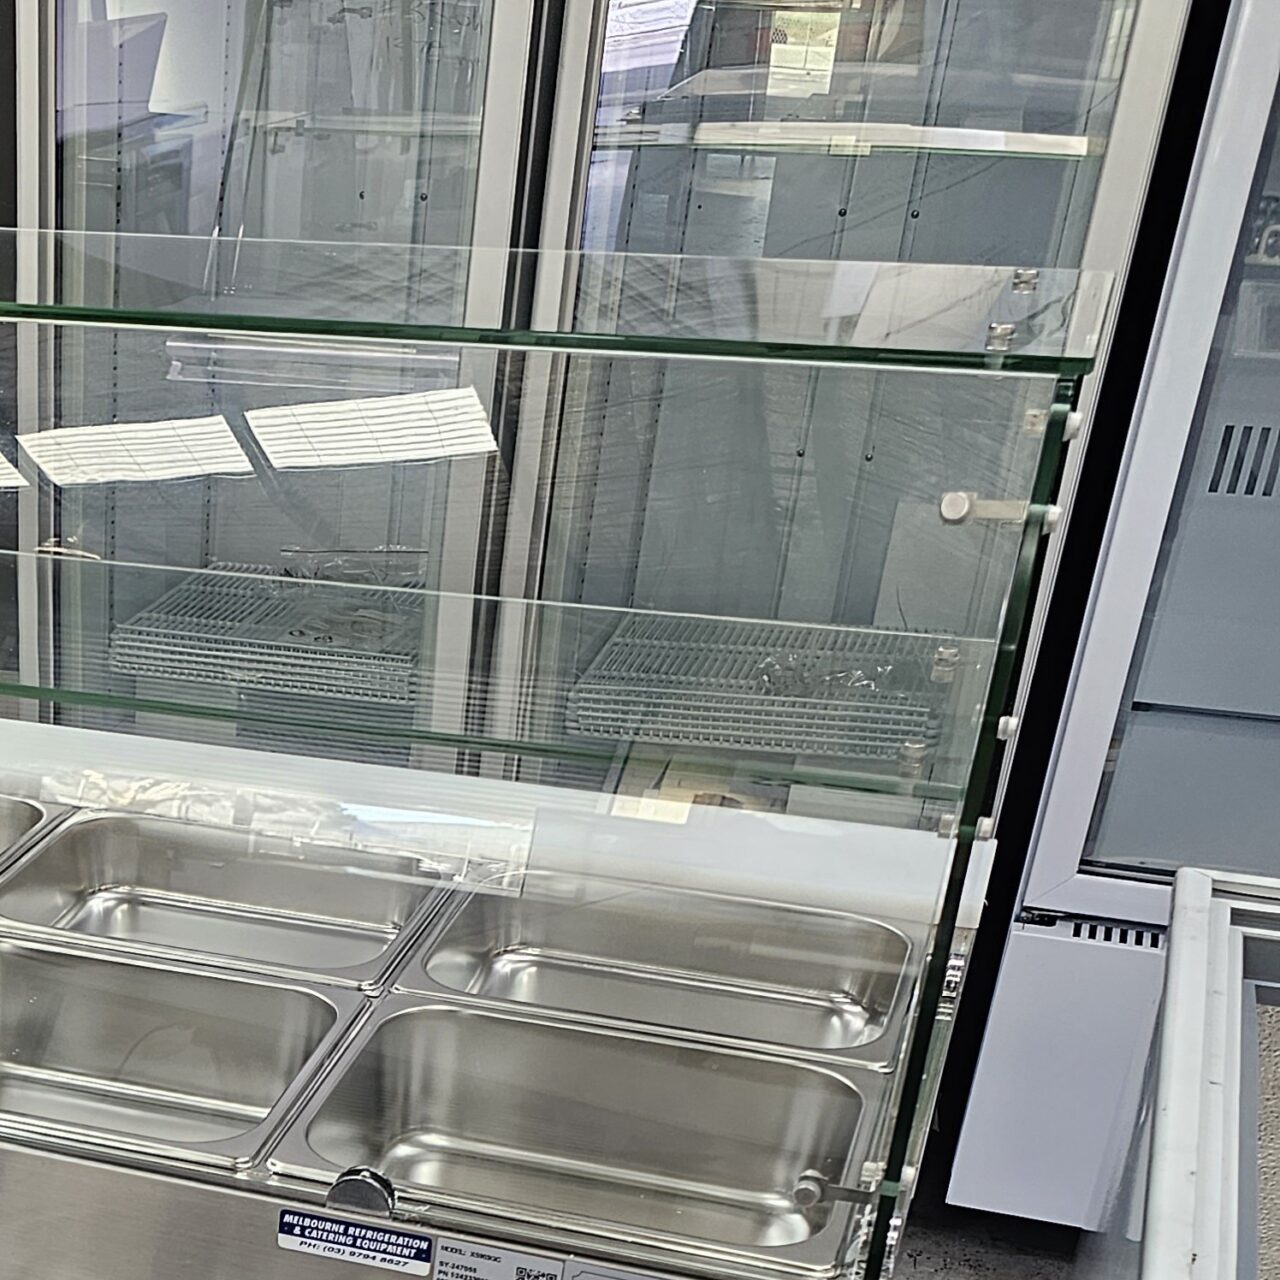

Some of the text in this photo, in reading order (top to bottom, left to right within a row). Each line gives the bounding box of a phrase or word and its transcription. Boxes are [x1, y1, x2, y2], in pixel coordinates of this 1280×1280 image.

[283, 1214, 429, 1250] MELBOURNE REFRIGERATION
[293, 1226, 417, 1258] & CATERING EQUIPMENT
[323, 1245, 346, 1256] (03)
[349, 1251, 377, 1261] 9794
